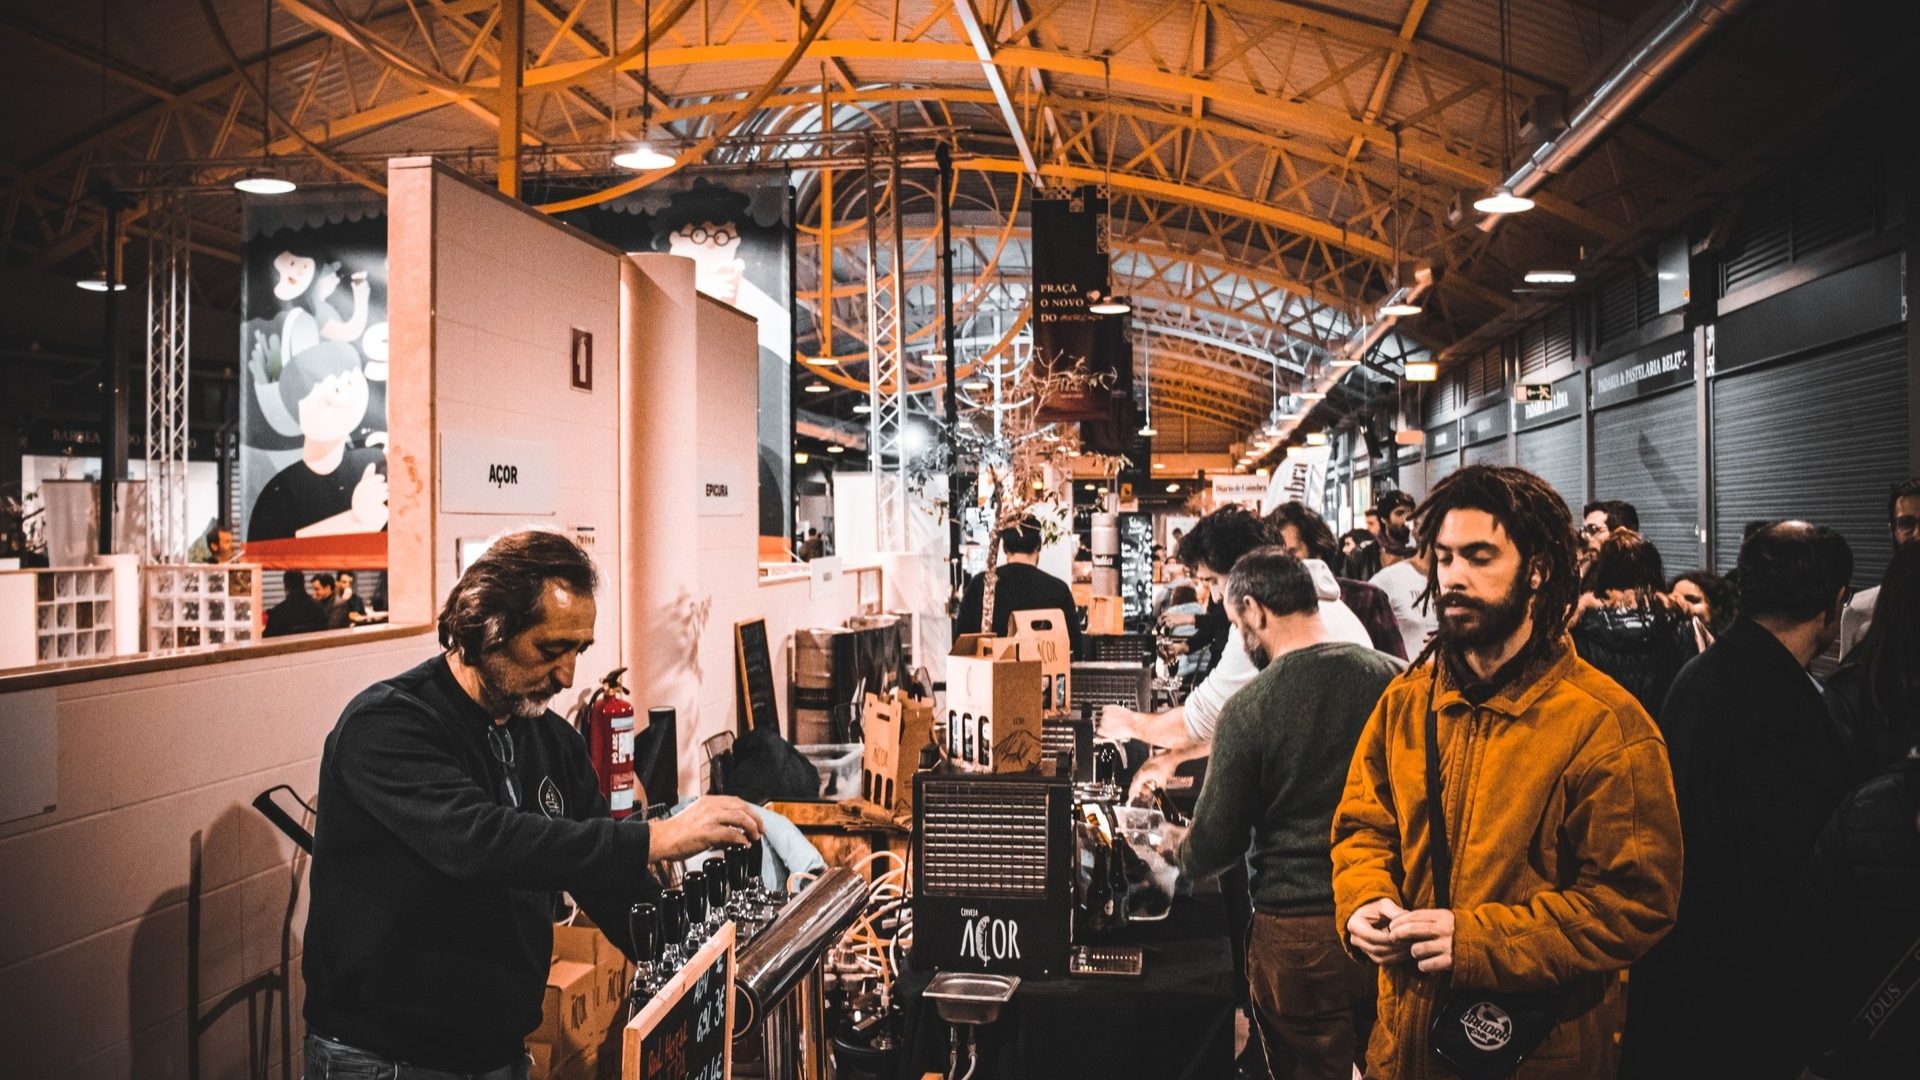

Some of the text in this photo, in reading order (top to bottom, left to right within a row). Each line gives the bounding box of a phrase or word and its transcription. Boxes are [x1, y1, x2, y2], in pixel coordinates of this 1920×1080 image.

[1040, 284, 1077, 294] PRAÇA
[1040, 299, 1084, 307] O NOVO
[1040, 314, 1057, 322] DO
[1625, 359, 1662, 385] PASTELARIA
[488, 464, 518, 488] AÇOR
[705, 483, 728, 497] EPICURA
[960, 916, 1021, 967] AÇOR
[1863, 982, 1901, 1026] TOUS
